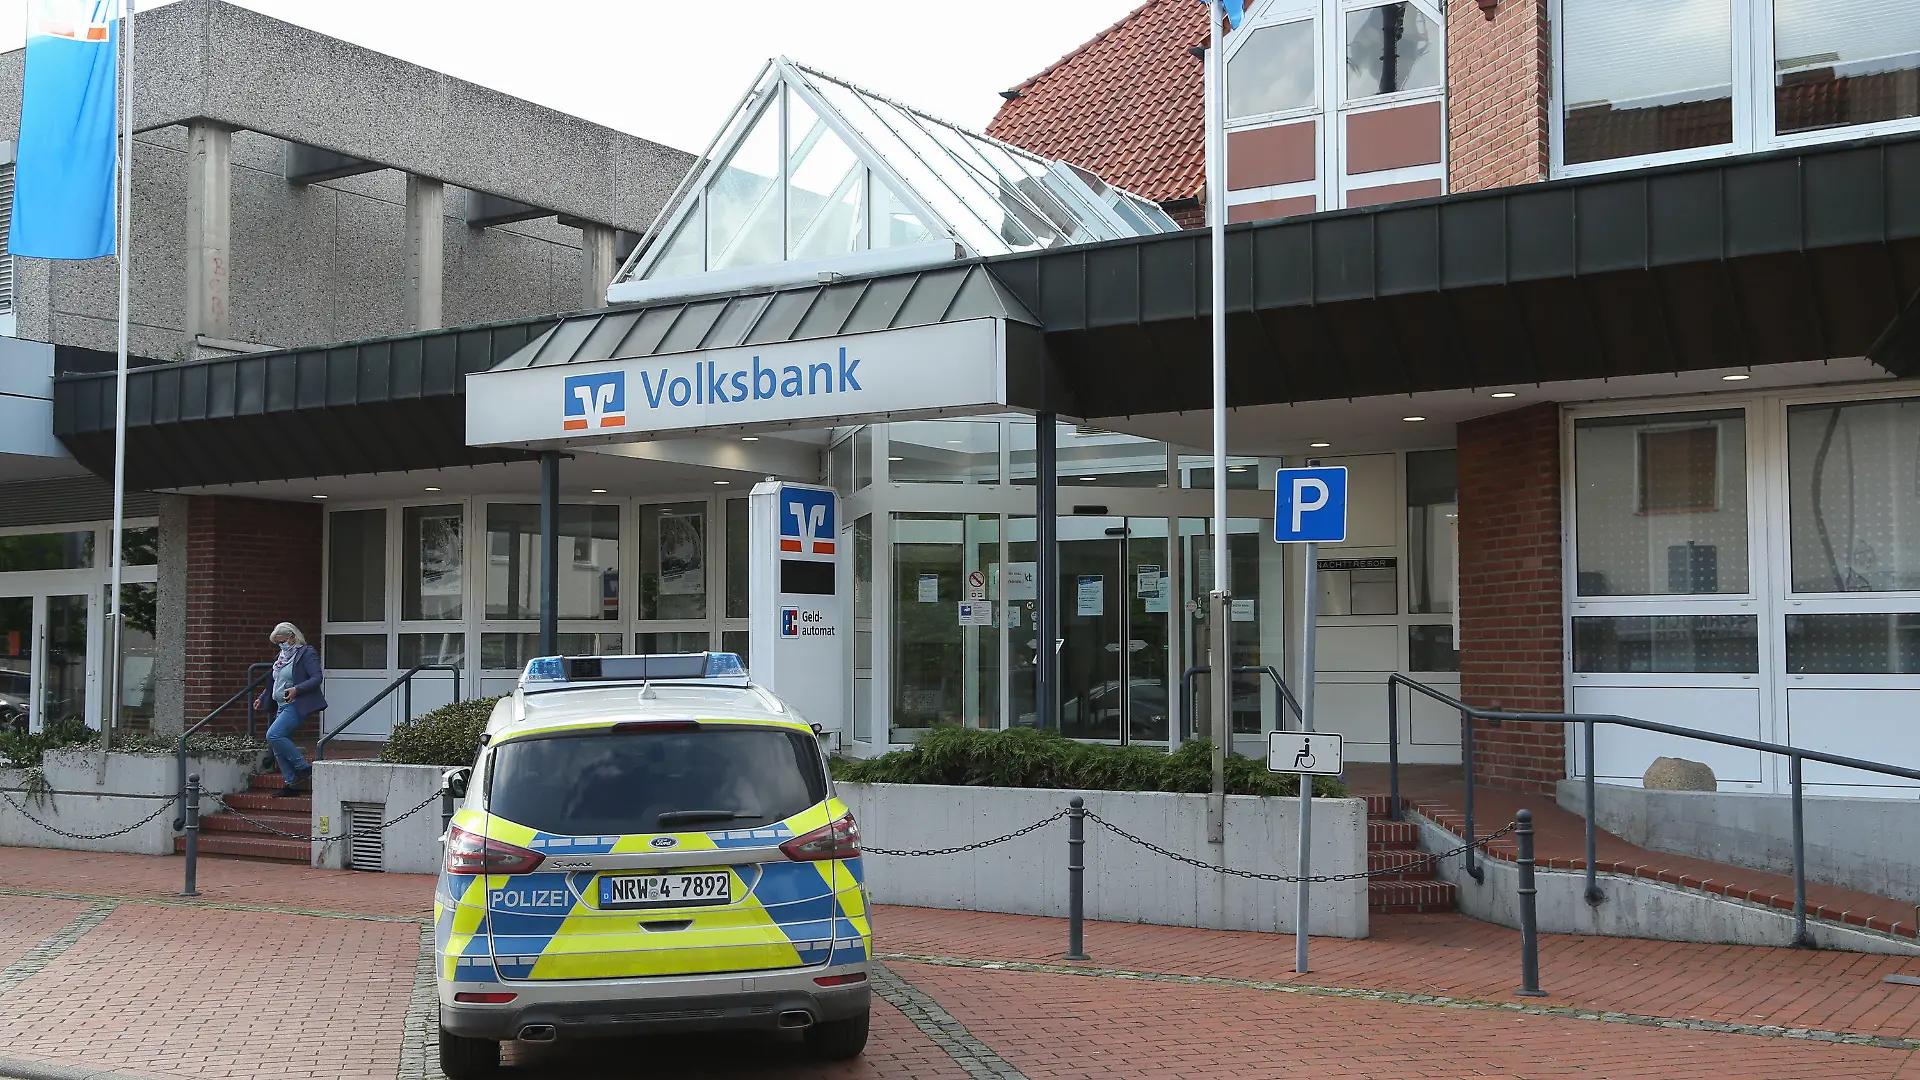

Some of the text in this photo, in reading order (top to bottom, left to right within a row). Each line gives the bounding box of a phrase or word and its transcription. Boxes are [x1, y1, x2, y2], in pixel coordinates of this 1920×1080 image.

[640, 346, 862, 409] Volksbank
[1291, 478, 1329, 532] P
[802, 610, 823, 622] Geld-
[802, 625, 836, 636] automat
[655, 837, 672, 846] Ford
[612, 878, 649, 900] NRW
[491, 890, 569, 908] POLIZEI
